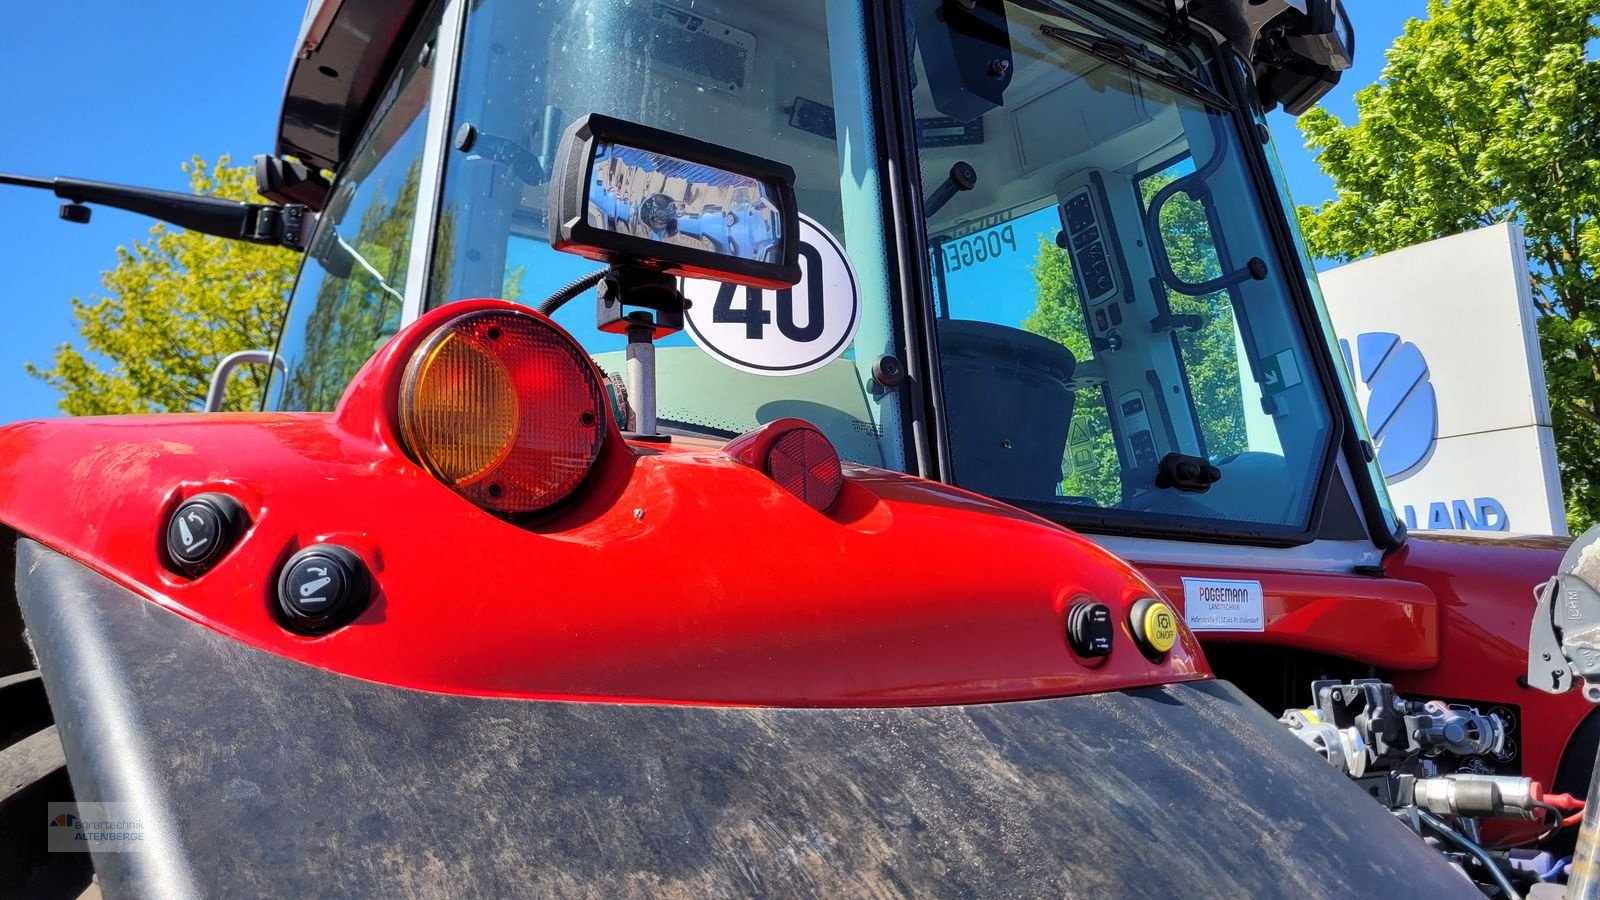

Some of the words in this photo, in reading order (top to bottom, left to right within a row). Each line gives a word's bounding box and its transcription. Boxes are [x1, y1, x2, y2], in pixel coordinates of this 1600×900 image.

[713, 240, 825, 343] 40
[1199, 586, 1249, 603] POGGEMANN
[1208, 603, 1241, 611] LANDTECHNIK
[1155, 630, 1174, 640] ON/OFF
